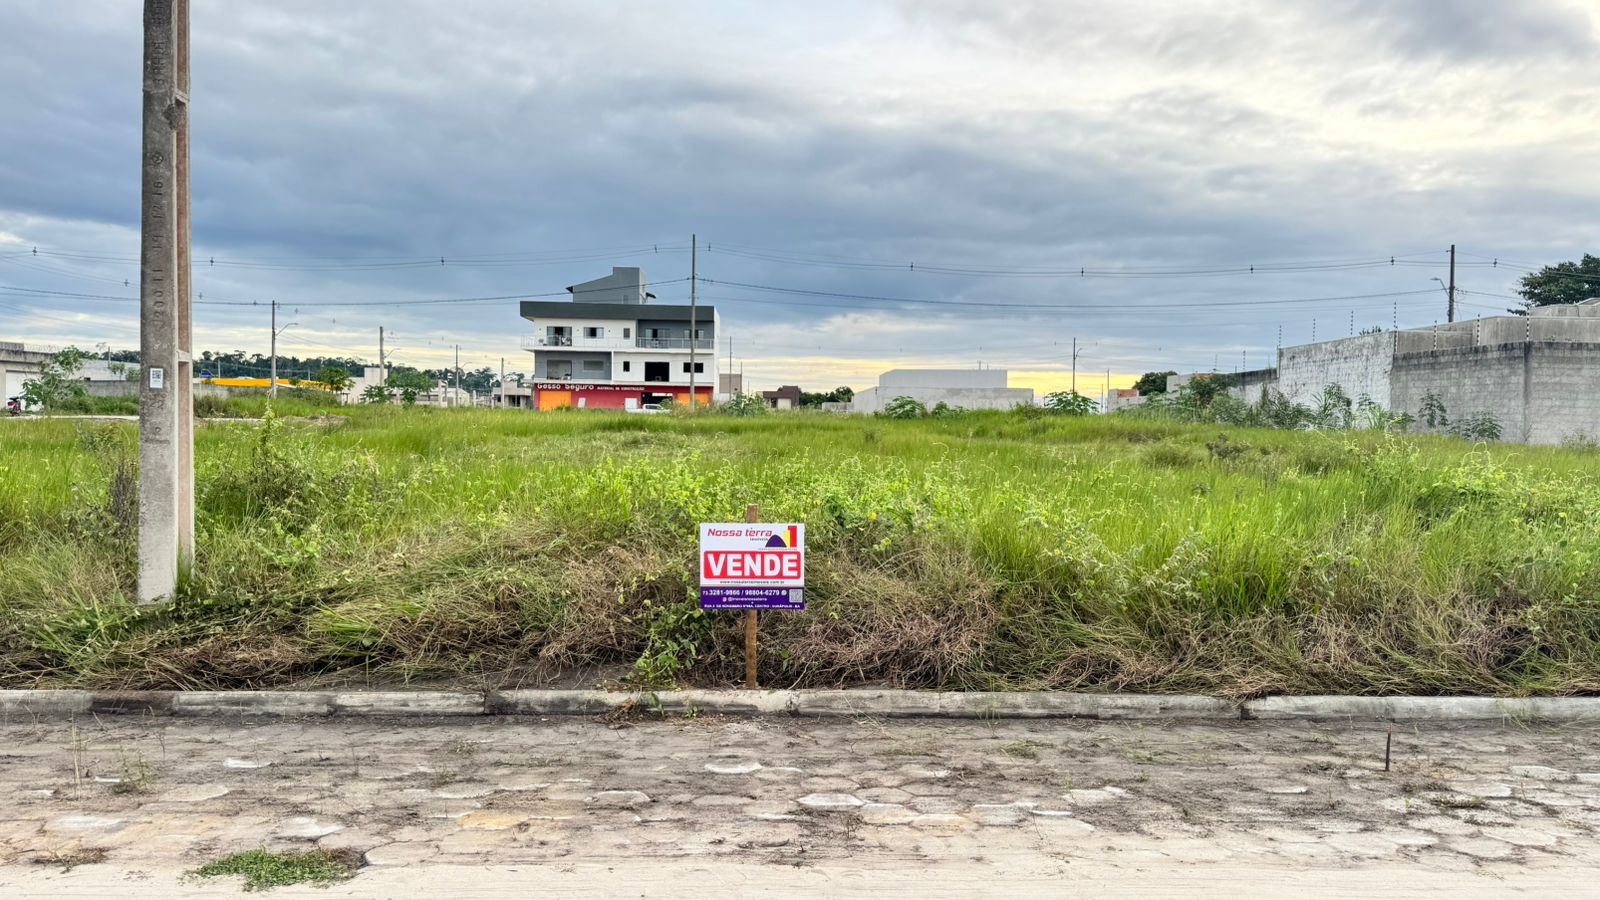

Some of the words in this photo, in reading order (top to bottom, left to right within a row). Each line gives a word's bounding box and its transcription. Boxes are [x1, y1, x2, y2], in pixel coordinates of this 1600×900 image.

[565, 383, 594, 391] Seguro
[707, 528, 742, 536] Nossa
[707, 553, 798, 576] VENDE
